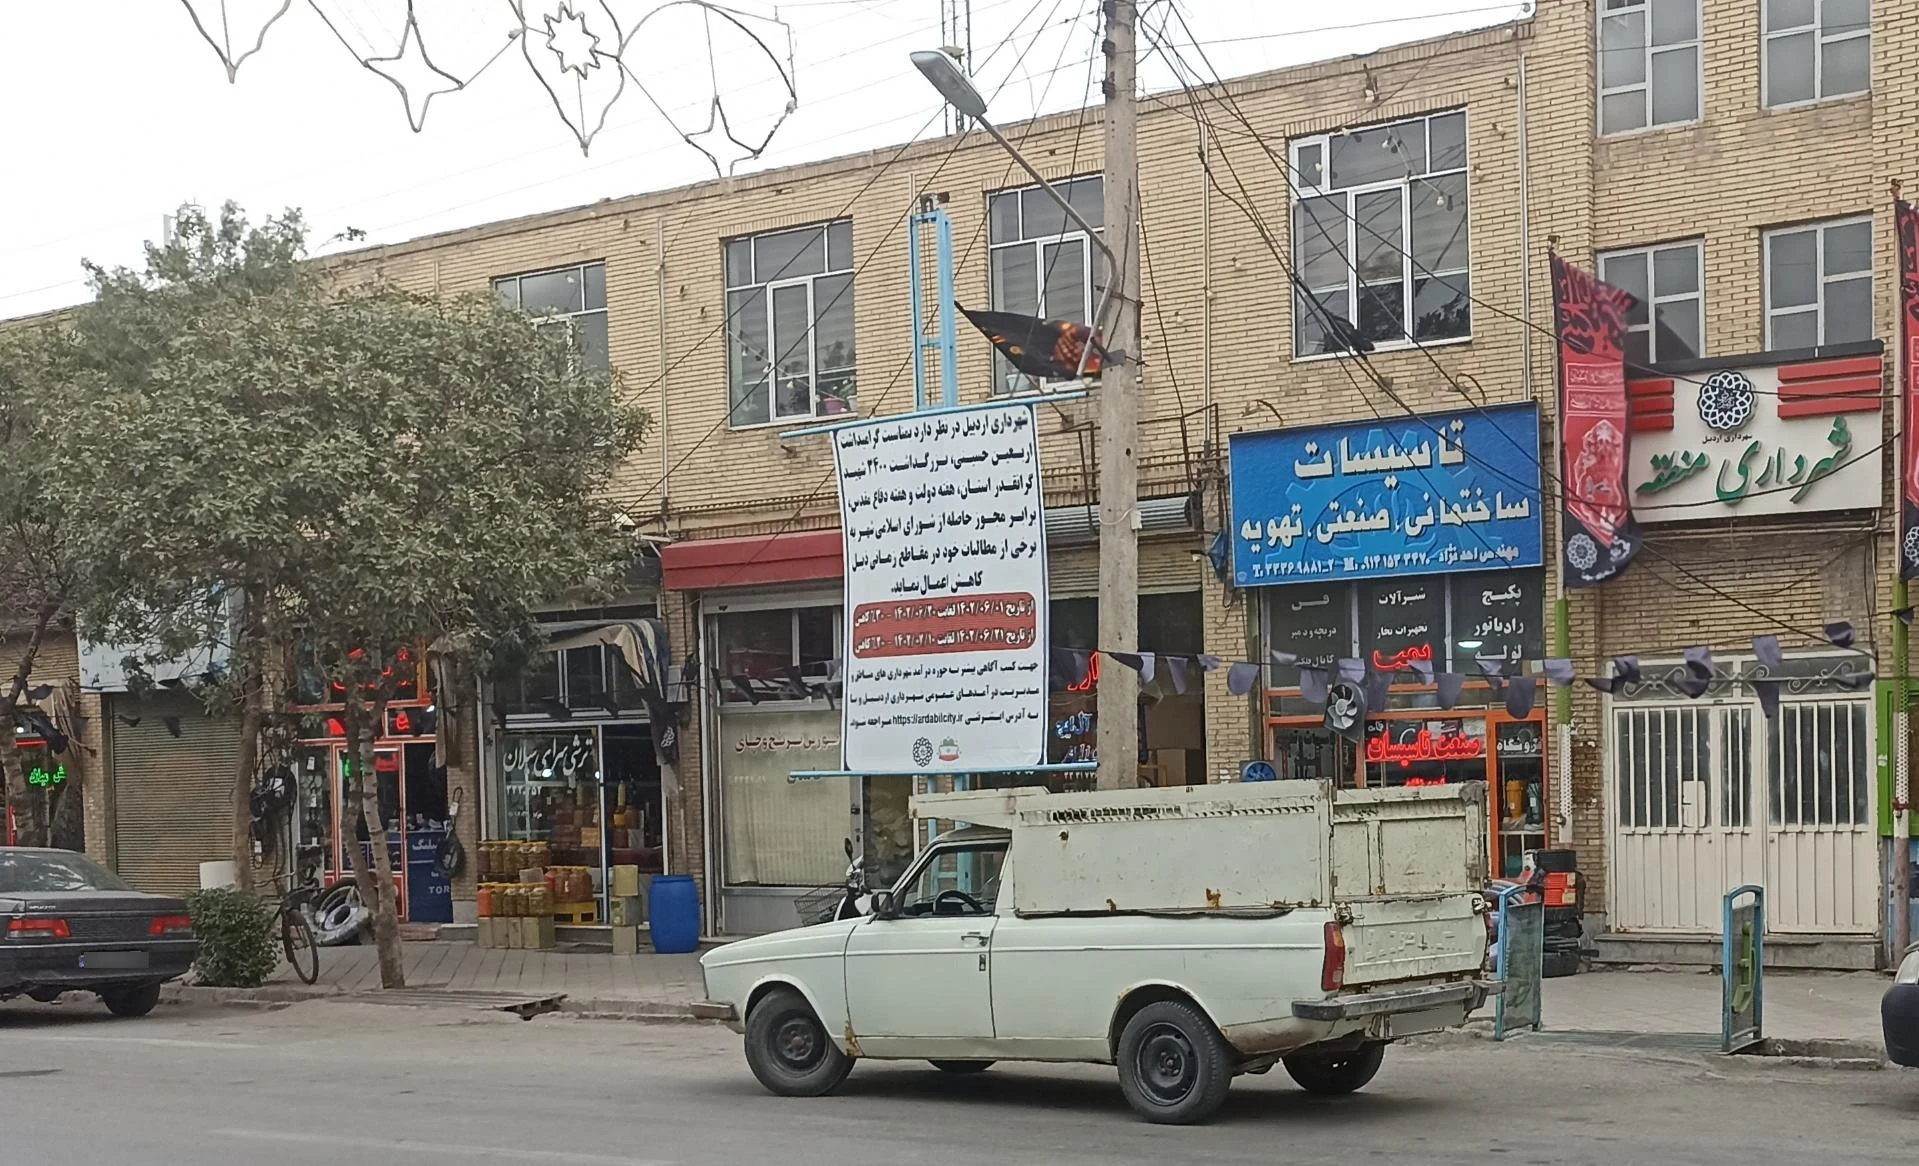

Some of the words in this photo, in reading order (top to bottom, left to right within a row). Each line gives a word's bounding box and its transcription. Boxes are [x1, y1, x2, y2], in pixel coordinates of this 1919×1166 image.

[934, 417, 948, 441] نظر
[951, 421, 960, 439] در
[963, 414, 988, 437] اردبیل
[991, 410, 1028, 434] شهرداری
[840, 428, 880, 449] گرامیداشت
[914, 422, 932, 443] دارد
[1702, 434, 1722, 444] اردبیل
[1724, 433, 1752, 443] شهرداری
[889, 452, 948, 472] بزرگداشت
[992, 442, 1033, 466] اربعین
[1295, 419, 1464, 488] تاسیسات
[1715, 415, 1852, 505] شهرداری
[844, 461, 866, 481] شهید
[889, 488, 907, 502] هفته
[915, 483, 936, 503] دولت
[938, 482, 954, 496] هفته
[994, 473, 1033, 498] گرانقدر
[872, 487, 888, 510] دفاع
[908, 491, 913, 505] و
[903, 514, 936, 536] شورای
[938, 512, 946, 533] از
[946, 510, 972, 526] حاصله
[975, 511, 1006, 530] مجوز
[1009, 506, 1036, 528] برابر
[849, 527, 856, 538] به
[858, 520, 874, 542] شهر
[875, 516, 901, 539] اسلامی
[1241, 503, 1303, 553] تهویه
[898, 545, 928, 567] مقاطع
[931, 547, 940, 565] در
[943, 541, 959, 563] خود
[961, 539, 997, 557] مطالبات
[999, 538, 1008, 560] از
[1011, 537, 1037, 559] برخی
[852, 551, 868, 572] ذیل
[869, 549, 896, 570] زمانی
[920, 573, 948, 595] اعمال
[951, 570, 983, 593] کاهش
[1378, 587, 1426, 605] شیرآلات
[1482, 583, 1522, 606] پکیج
[1006, 598, 1025, 616] تاریخ
[1026, 599, 1034, 616] از
[1026, 628, 1034, 643] از
[1314, 626, 1337, 639] دریچه
[1395, 621, 1428, 637] تجهیزات
[1473, 615, 1524, 636] رادیاتور
[1006, 628, 1025, 644] تاریخ
[1475, 644, 1522, 665] لوله
[874, 668, 886, 681] های
[887, 667, 912, 681] شهرداری
[932, 667, 948, 678] حوزه
[976, 659, 998, 676] آگاهی
[1000, 660, 1016, 671] کسب
[1017, 662, 1038, 672] جهت
[863, 692, 889, 705] اردبیل
[890, 691, 924, 704] شهرداری
[925, 691, 954, 703] عمومی
[999, 687, 1040, 699] مدیریت
[867, 716, 892, 728] مراجعه
[892, 712, 963, 727] https://ardabilcity.ir
[964, 711, 1004, 725] اینترنتی
[1005, 707, 1026, 723] آدرس
[1027, 711, 1038, 719] به
[563, 734, 593, 776] ترشی
[1367, 728, 1432, 767] تاسیسات
[1434, 732, 1481, 759] صنعت
[533, 736, 568, 777] سرای
